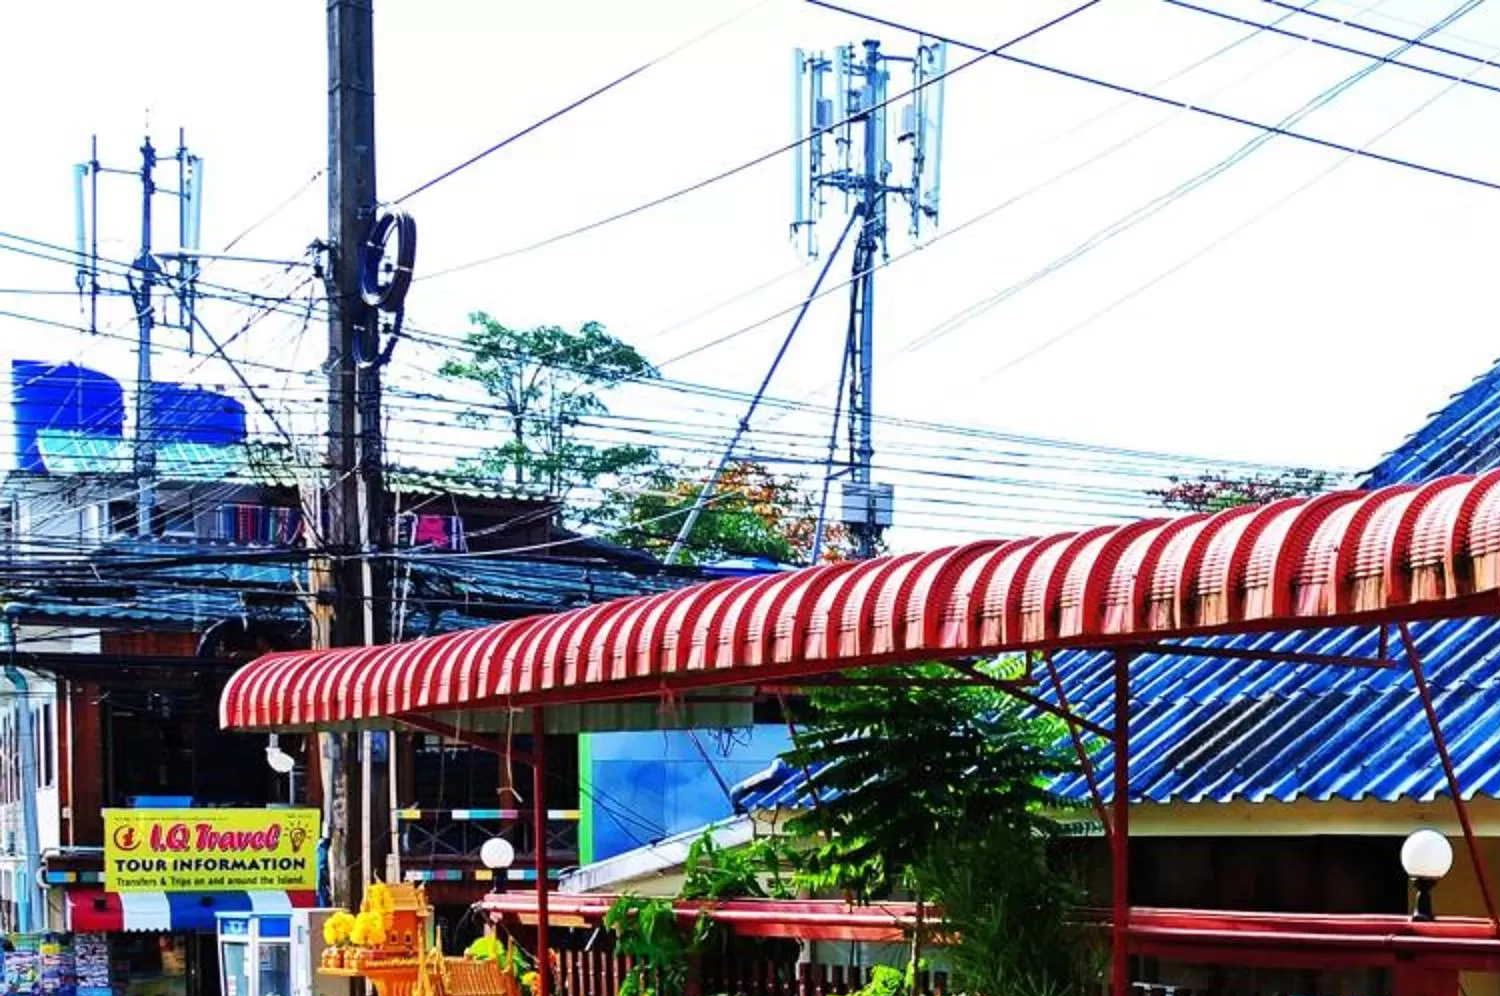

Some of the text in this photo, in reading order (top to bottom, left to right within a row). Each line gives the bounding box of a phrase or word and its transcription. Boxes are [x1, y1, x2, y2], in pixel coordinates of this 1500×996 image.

[195, 822, 282, 853] Travel
[114, 857, 306, 873] TOUR INFORMATION
[116, 876, 158, 887] Transfers
[160, 876, 167, 886] &
[170, 876, 192, 888] Trips
[208, 876, 225, 886] and
[227, 876, 258, 886] around
[260, 876, 275, 885] the
